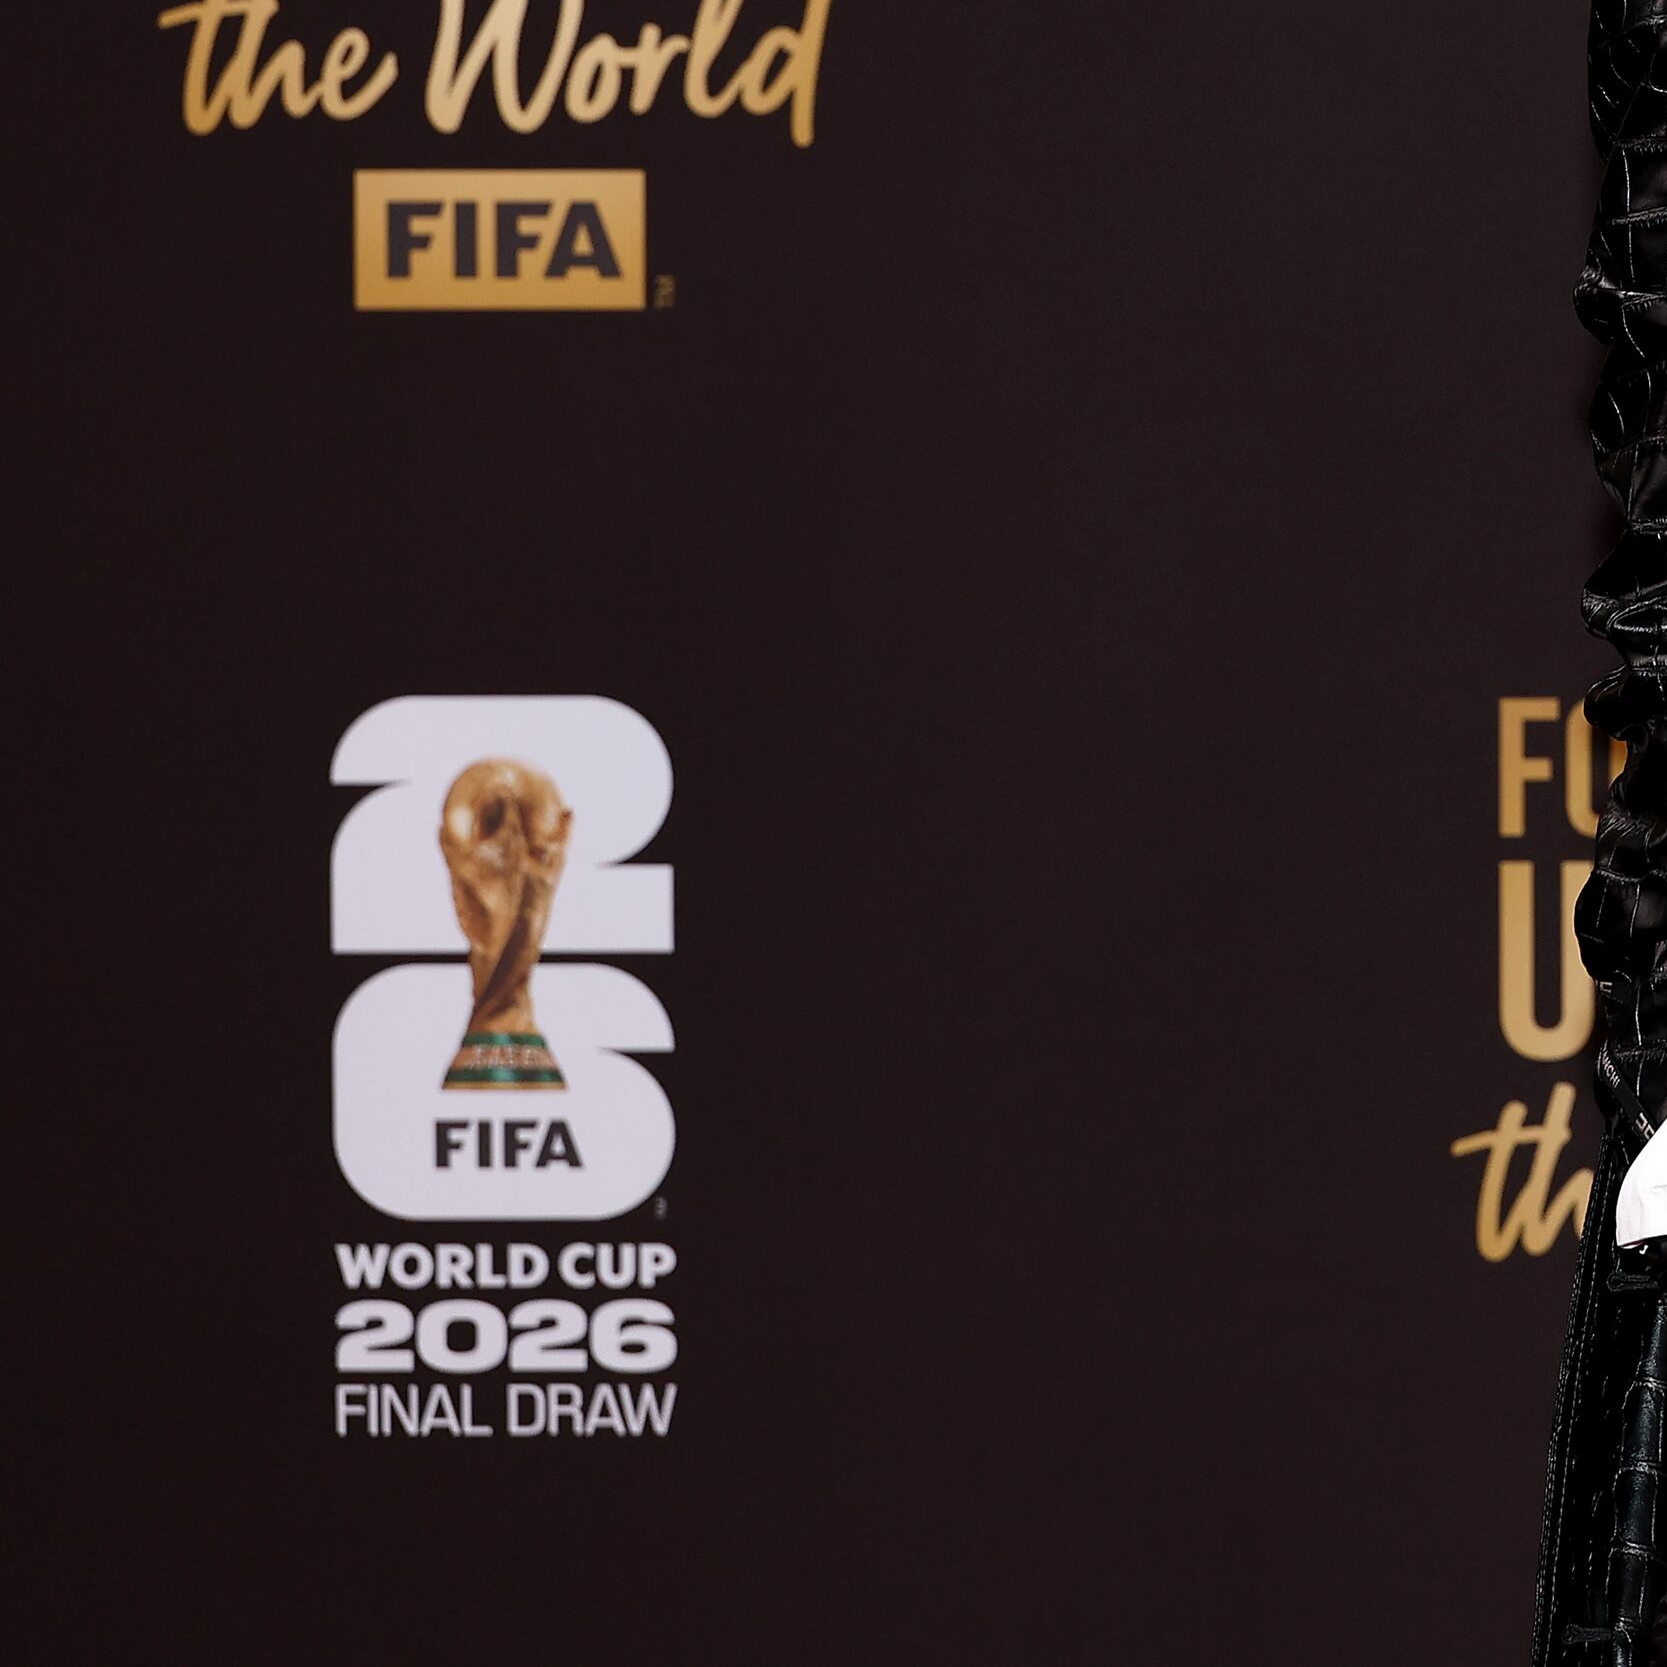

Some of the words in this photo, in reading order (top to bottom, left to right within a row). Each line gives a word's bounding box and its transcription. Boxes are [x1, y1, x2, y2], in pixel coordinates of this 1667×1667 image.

[387, 202, 621, 279] FIFA
[436, 1121, 582, 1168] FIFA
[1450, 1081, 1593, 1262] th
[336, 1243, 549, 1288] WORLD
[559, 1243, 676, 1288] CUP
[336, 1299, 677, 1373] 2026
[336, 1384, 493, 1436] FINAL
[507, 1383, 677, 1436] DRAW
